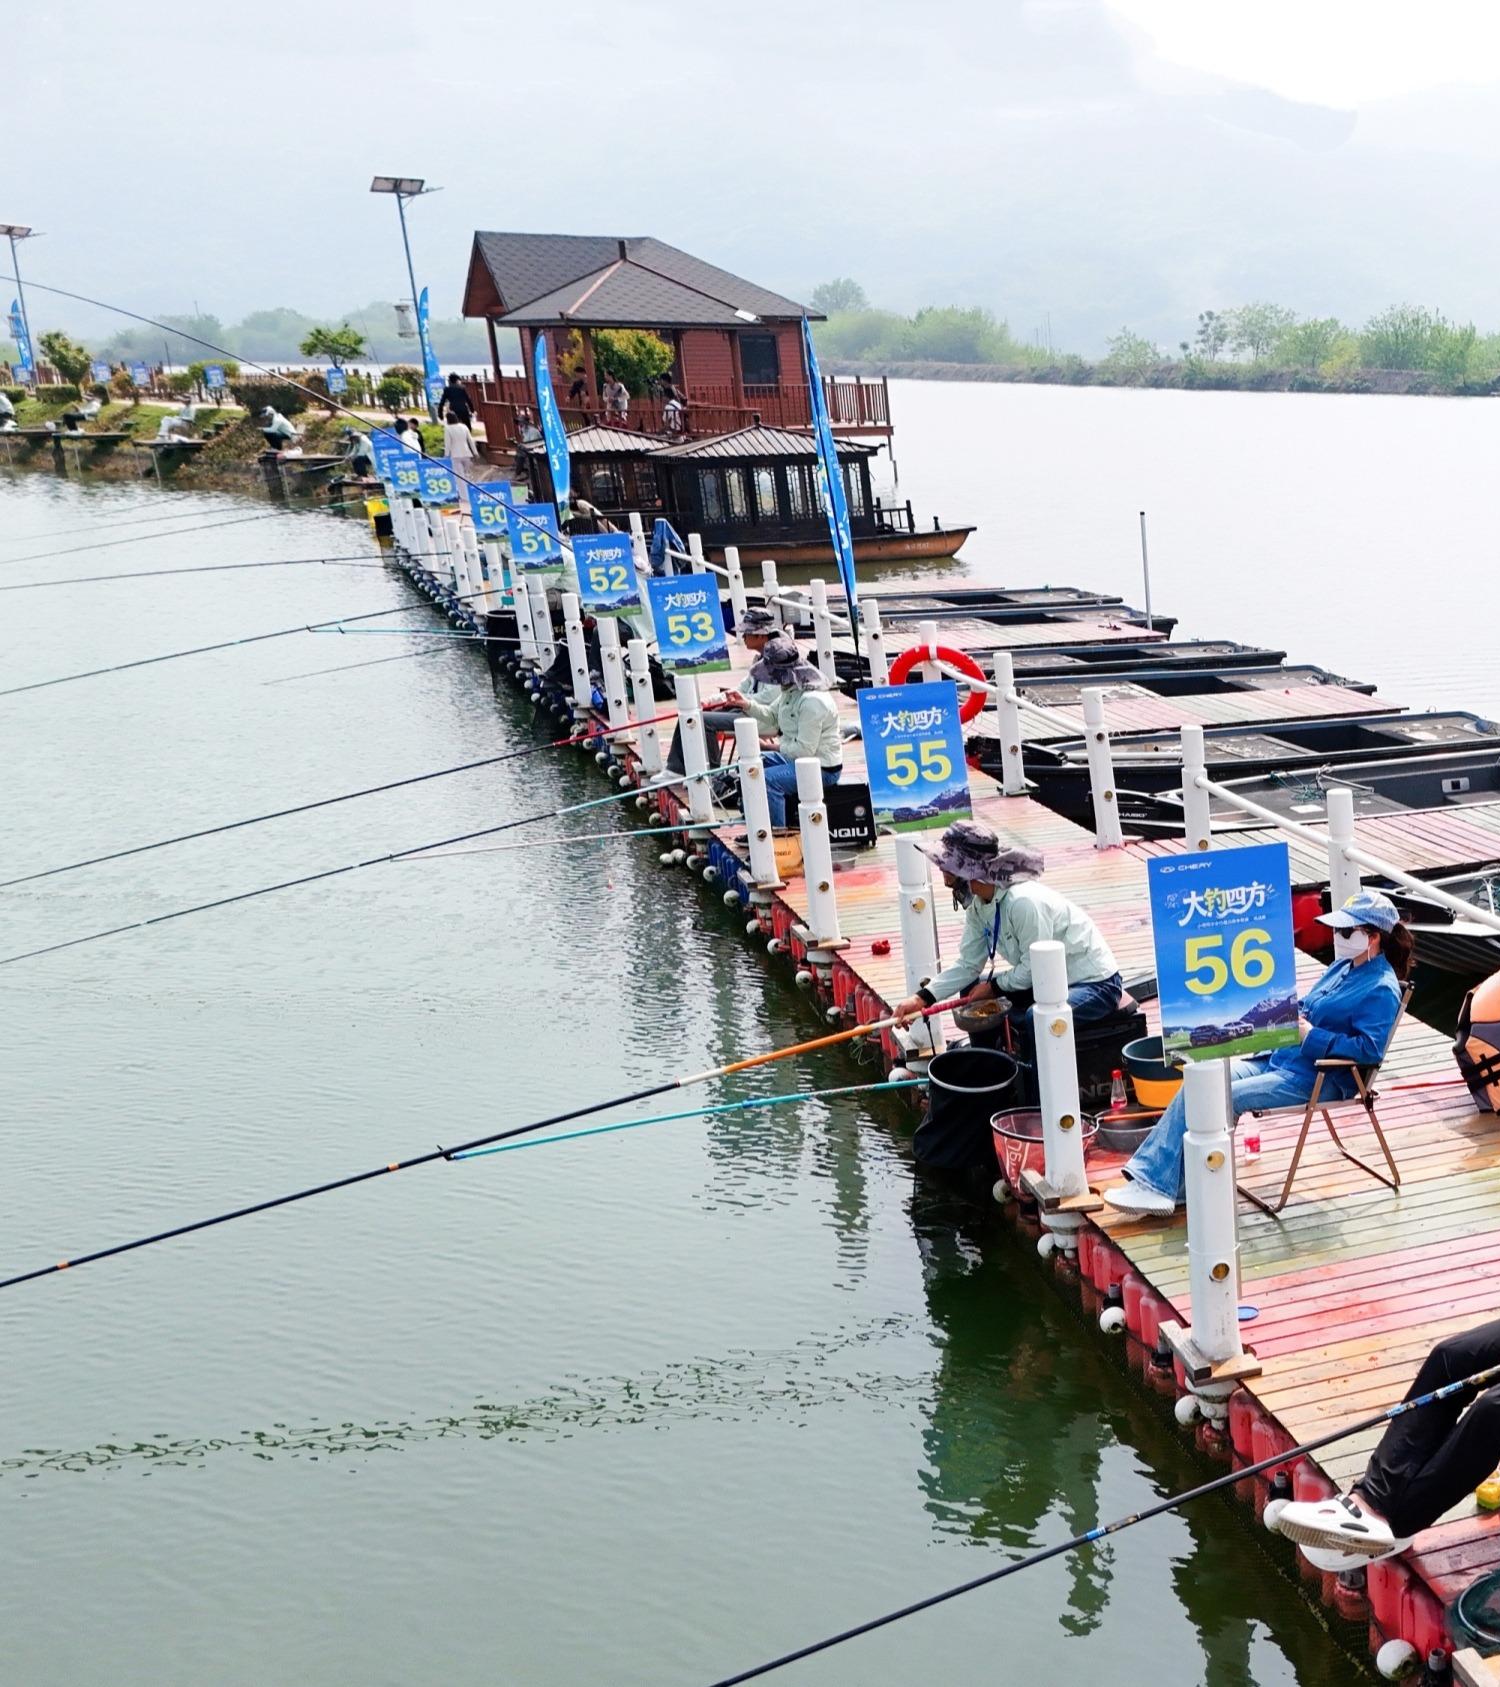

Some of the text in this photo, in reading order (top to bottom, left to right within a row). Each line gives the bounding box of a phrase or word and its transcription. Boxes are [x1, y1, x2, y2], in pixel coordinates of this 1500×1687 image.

[396, 470, 419, 485] 38
[426, 478, 452, 495] 39
[479, 504, 507, 525] 50
[521, 530, 552, 553] 51
[589, 565, 630, 592] 52
[667, 611, 716, 644] 53
[880, 706, 942, 738] 大钓四方
[885, 739, 952, 787] 55
[1177, 862, 1212, 872] CHERY
[1178, 880, 1266, 927] 大钓四方
[1184, 927, 1276, 996] 56
